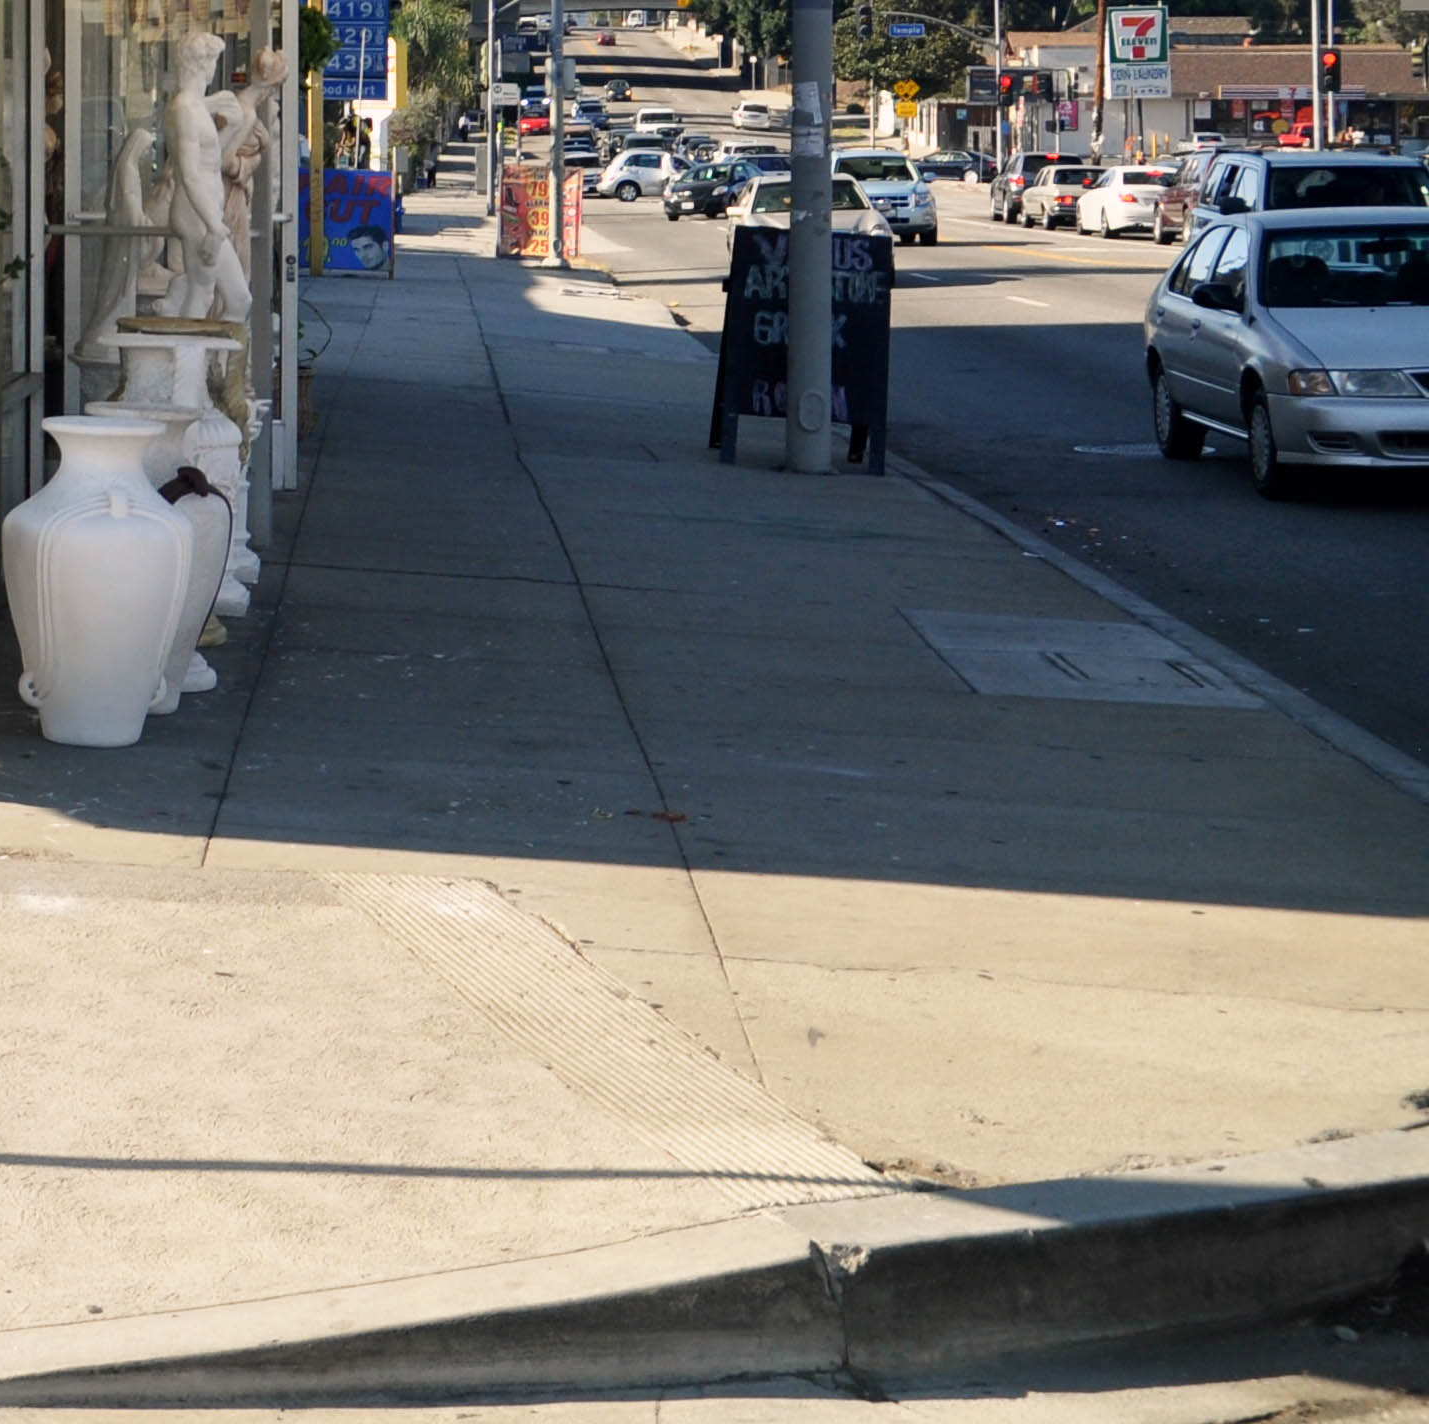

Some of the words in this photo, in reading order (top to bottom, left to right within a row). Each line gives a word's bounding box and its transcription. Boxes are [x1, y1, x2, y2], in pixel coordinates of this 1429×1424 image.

[328, 1, 373, 18] 419
[1122, 16, 1156, 59] 7
[323, 82, 343, 95] ood
[753, 234, 873, 271] VUS
[754, 311, 848, 348] GRK
